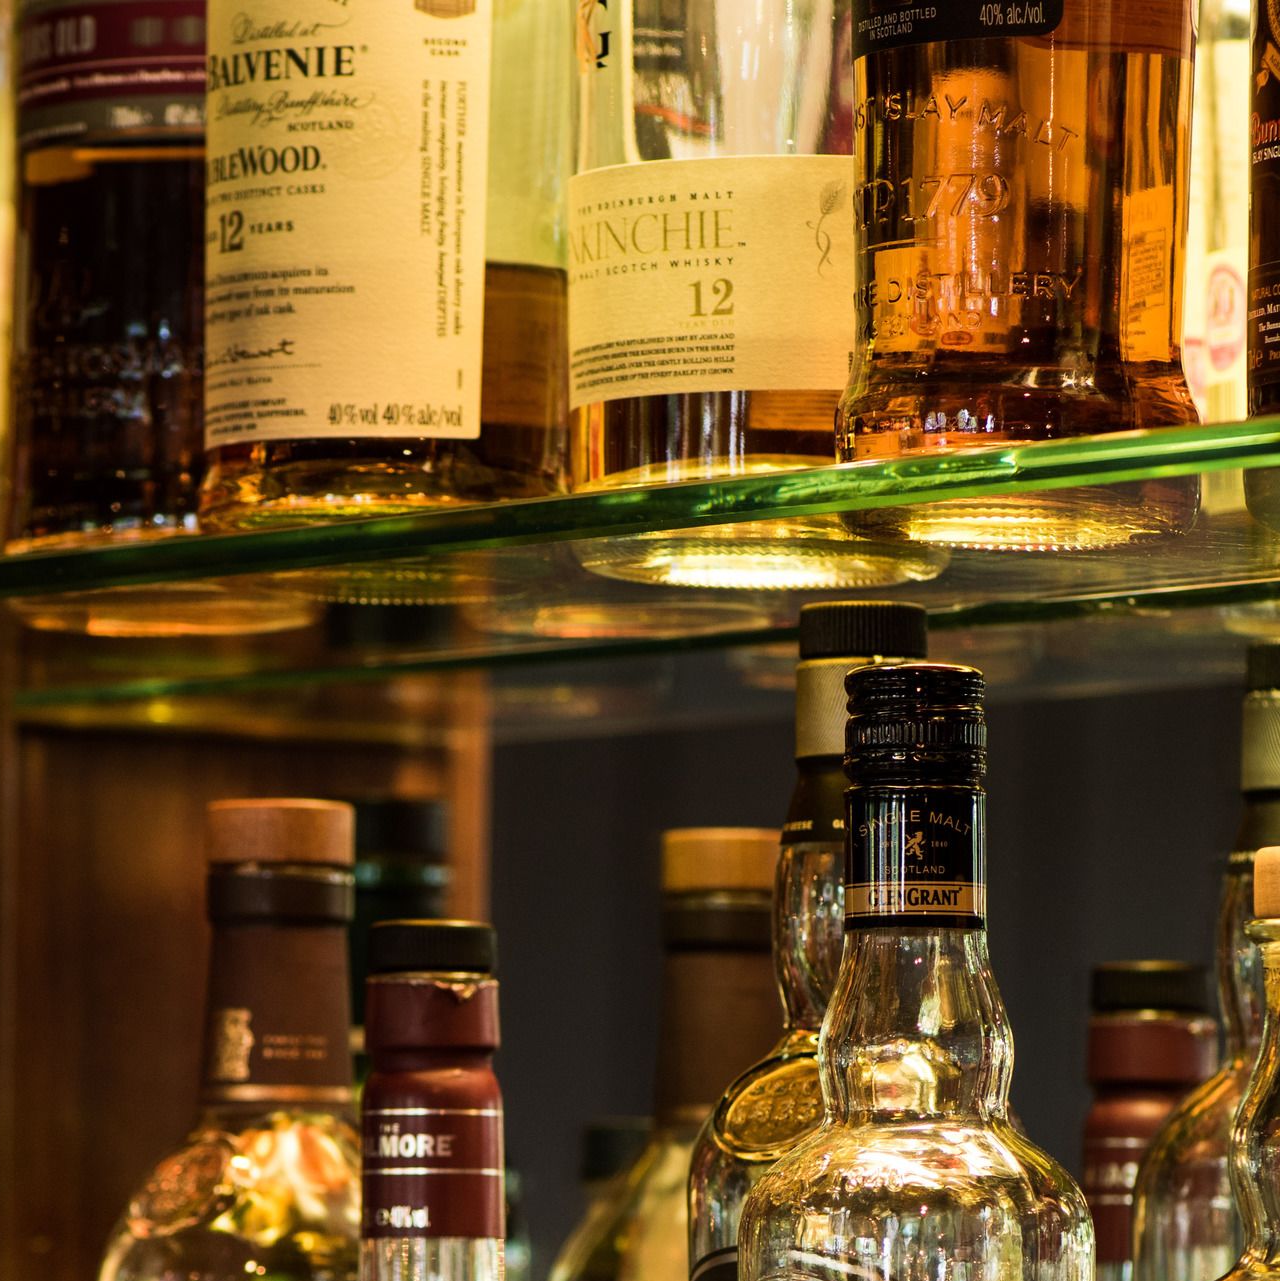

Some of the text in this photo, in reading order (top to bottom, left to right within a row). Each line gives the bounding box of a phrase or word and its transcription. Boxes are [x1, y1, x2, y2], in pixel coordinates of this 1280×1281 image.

[858, 7, 937, 33] DISTILLED AND BOTTLED
[979, 2, 1046, 26] 40% alc./vol.
[876, 21, 913, 39] SCOTLAND
[208, 45, 356, 92] BALVENIE
[287, 120, 354, 132] SCOTLAND
[978, 98, 1080, 153] MALT
[420, 156, 432, 199] SINGLE
[286, 183, 326, 196] CASKS
[598, 190, 735, 211] EDINBURGH MALT
[218, 210, 295, 254] 12 YEARS
[606, 256, 735, 276] SCOTCH WHISKY
[292, 283, 356, 296] maturation
[887, 266, 1083, 305] DISTILLERY
[688, 278, 735, 318] 12
[719, 332, 735, 341] AND
[695, 343, 735, 354] THE HEART
[657, 356, 713, 368] GENTLY ROLLING
[707, 366, 734, 377] GROWN
[858, 809, 920, 838] SINGLE
[929, 811, 972, 836] MALT
[883, 864, 946, 876] SCOTLAND
[868, 885, 961, 908] GLENGRANT
